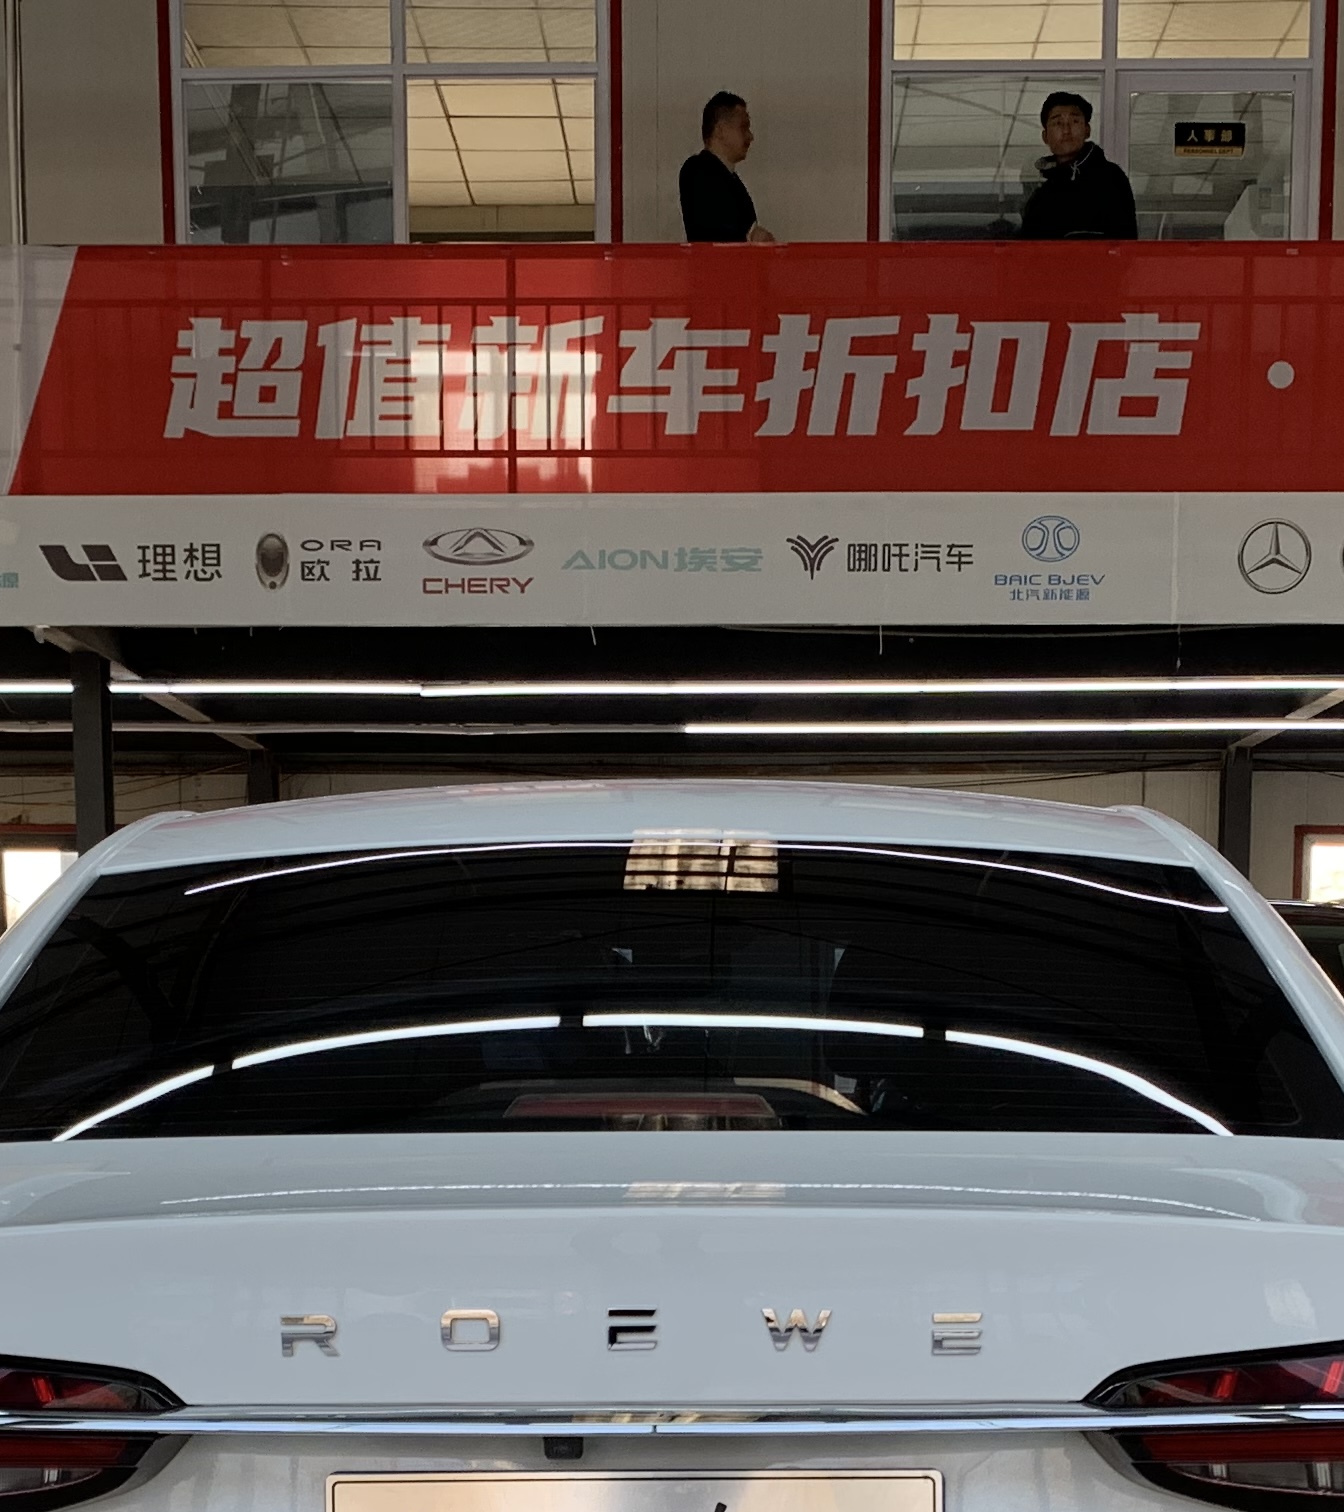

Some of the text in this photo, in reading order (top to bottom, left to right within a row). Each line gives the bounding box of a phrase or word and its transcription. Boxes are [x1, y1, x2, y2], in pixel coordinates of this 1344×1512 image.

[1187, 129, 1233, 142] 人事部
[300, 539, 382, 551] ORA
[136, 543, 224, 583] 理想
[847, 543, 974, 573] 哪吒汽车
[300, 558, 382, 582] 欧拉
[422, 577, 535, 594] CHERY
[994, 574, 1106, 586] BAIC BJEV
[1009, 588, 1090, 601] 北汽新能源
[279, 1306, 984, 1358] ROEWE
